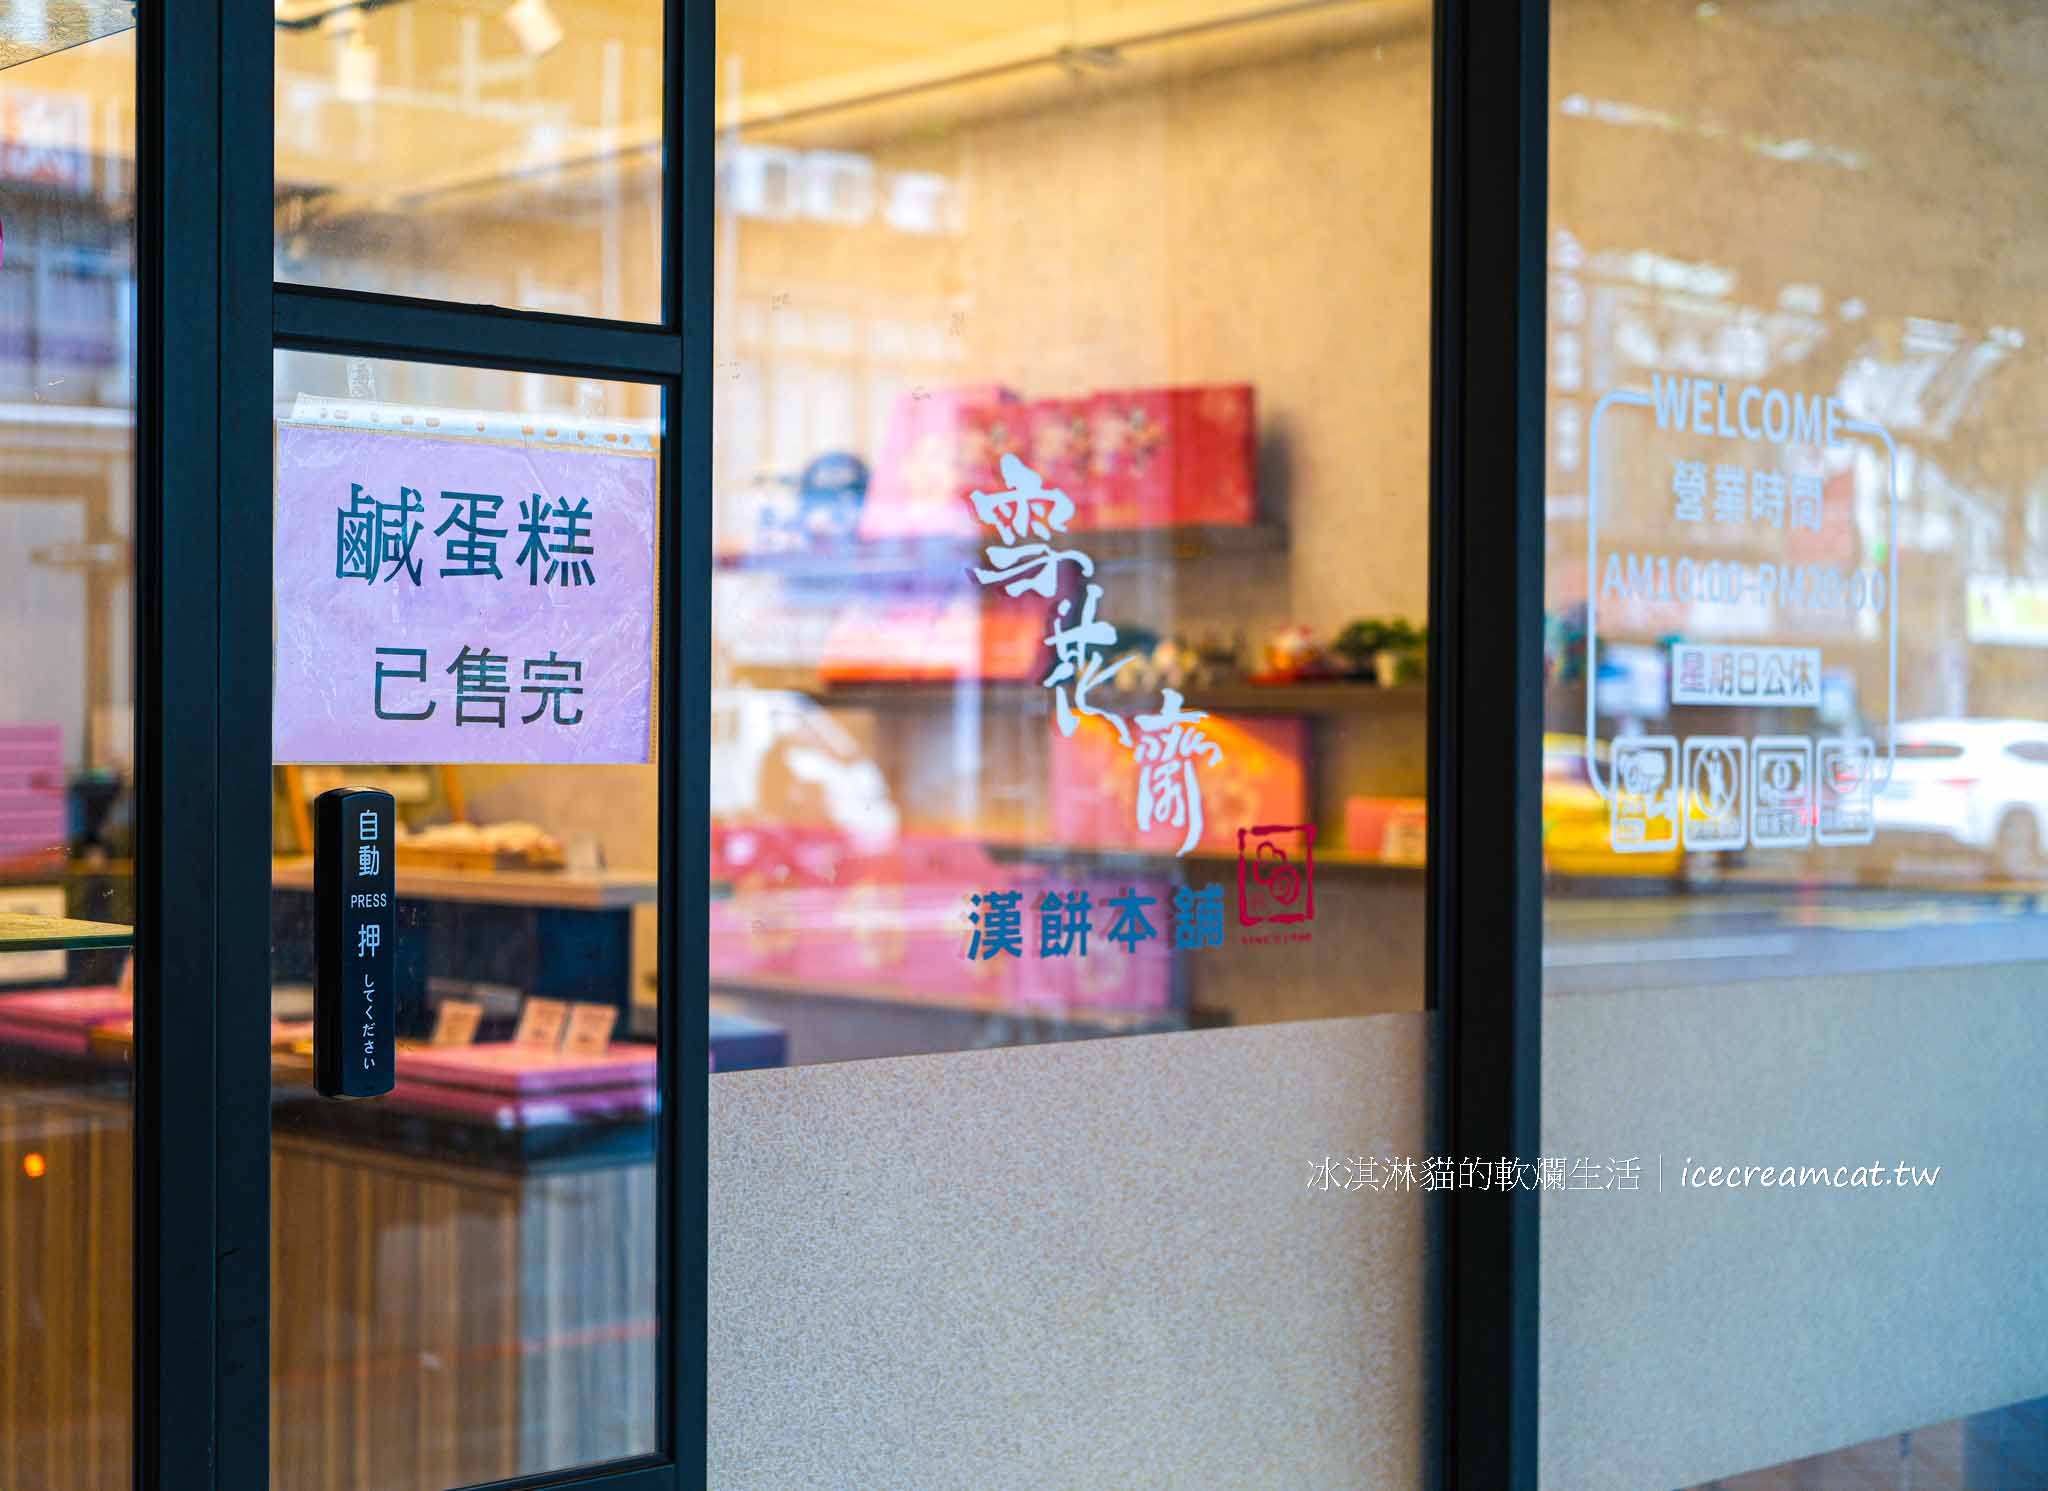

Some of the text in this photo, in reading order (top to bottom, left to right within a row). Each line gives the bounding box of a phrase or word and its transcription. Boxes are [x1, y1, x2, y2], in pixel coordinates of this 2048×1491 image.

[1652, 373, 1847, 449] WELCOME
[1673, 460, 1824, 533] 營業時間
[335, 483, 596, 587] 鹹蛋糕
[374, 645, 584, 729] 已售完
[1679, 651, 1816, 698] 星期日公休
[358, 809, 380, 877] 自動
[350, 893, 387, 908] PRESS
[967, 882, 1226, 960] 漢餅本舖
